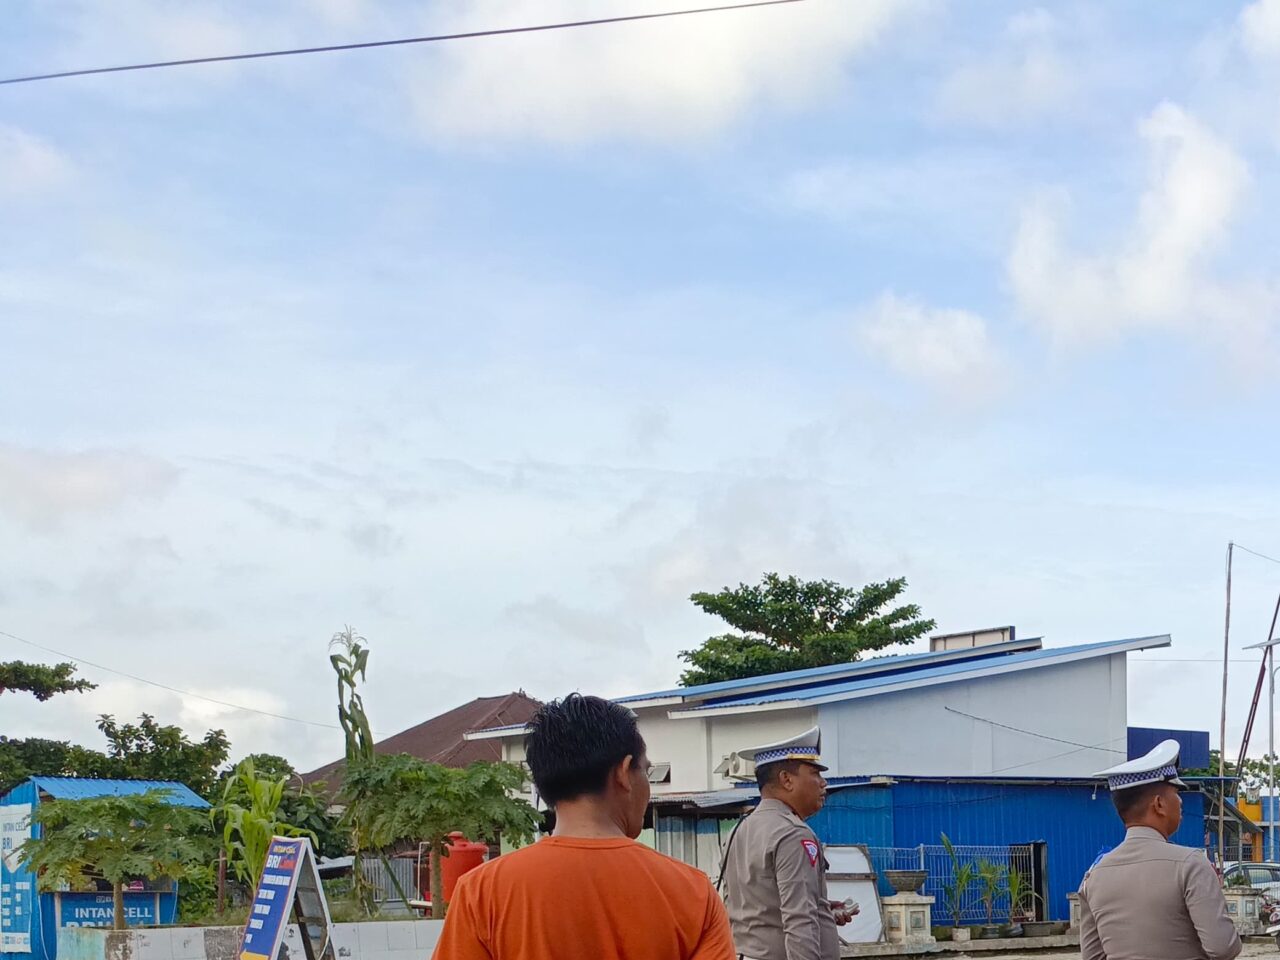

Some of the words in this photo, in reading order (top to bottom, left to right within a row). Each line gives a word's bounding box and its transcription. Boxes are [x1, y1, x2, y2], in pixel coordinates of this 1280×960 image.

[266, 855, 281, 869] BRI
[75, 907, 114, 918] INTAN
[122, 907, 152, 918] CELL
